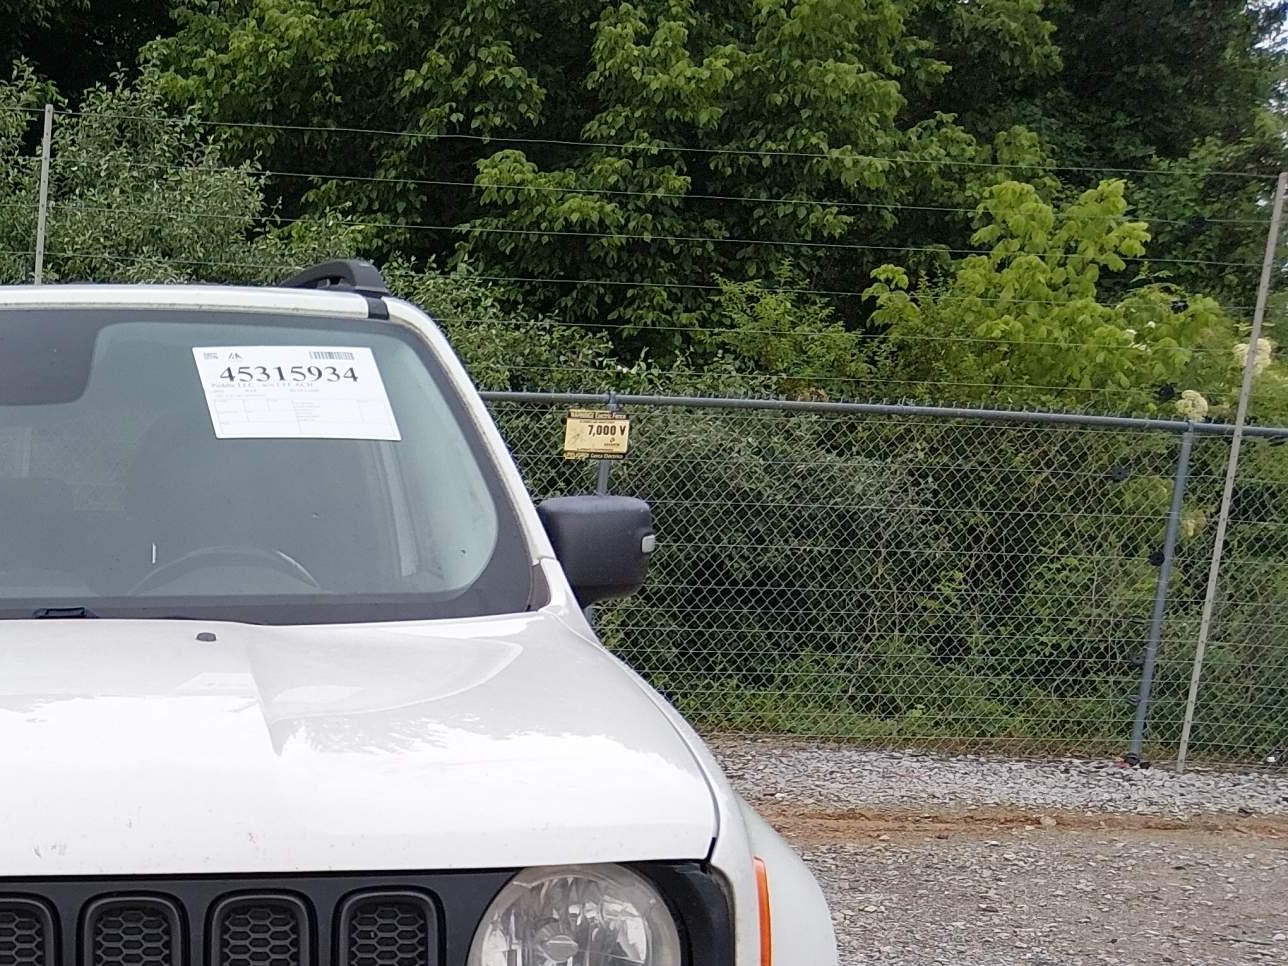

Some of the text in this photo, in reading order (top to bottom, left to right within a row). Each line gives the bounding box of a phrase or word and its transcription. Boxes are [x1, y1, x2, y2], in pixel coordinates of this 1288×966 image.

[219, 366, 359, 382] 45315934
[588, 424, 626, 437] 7,000 V
